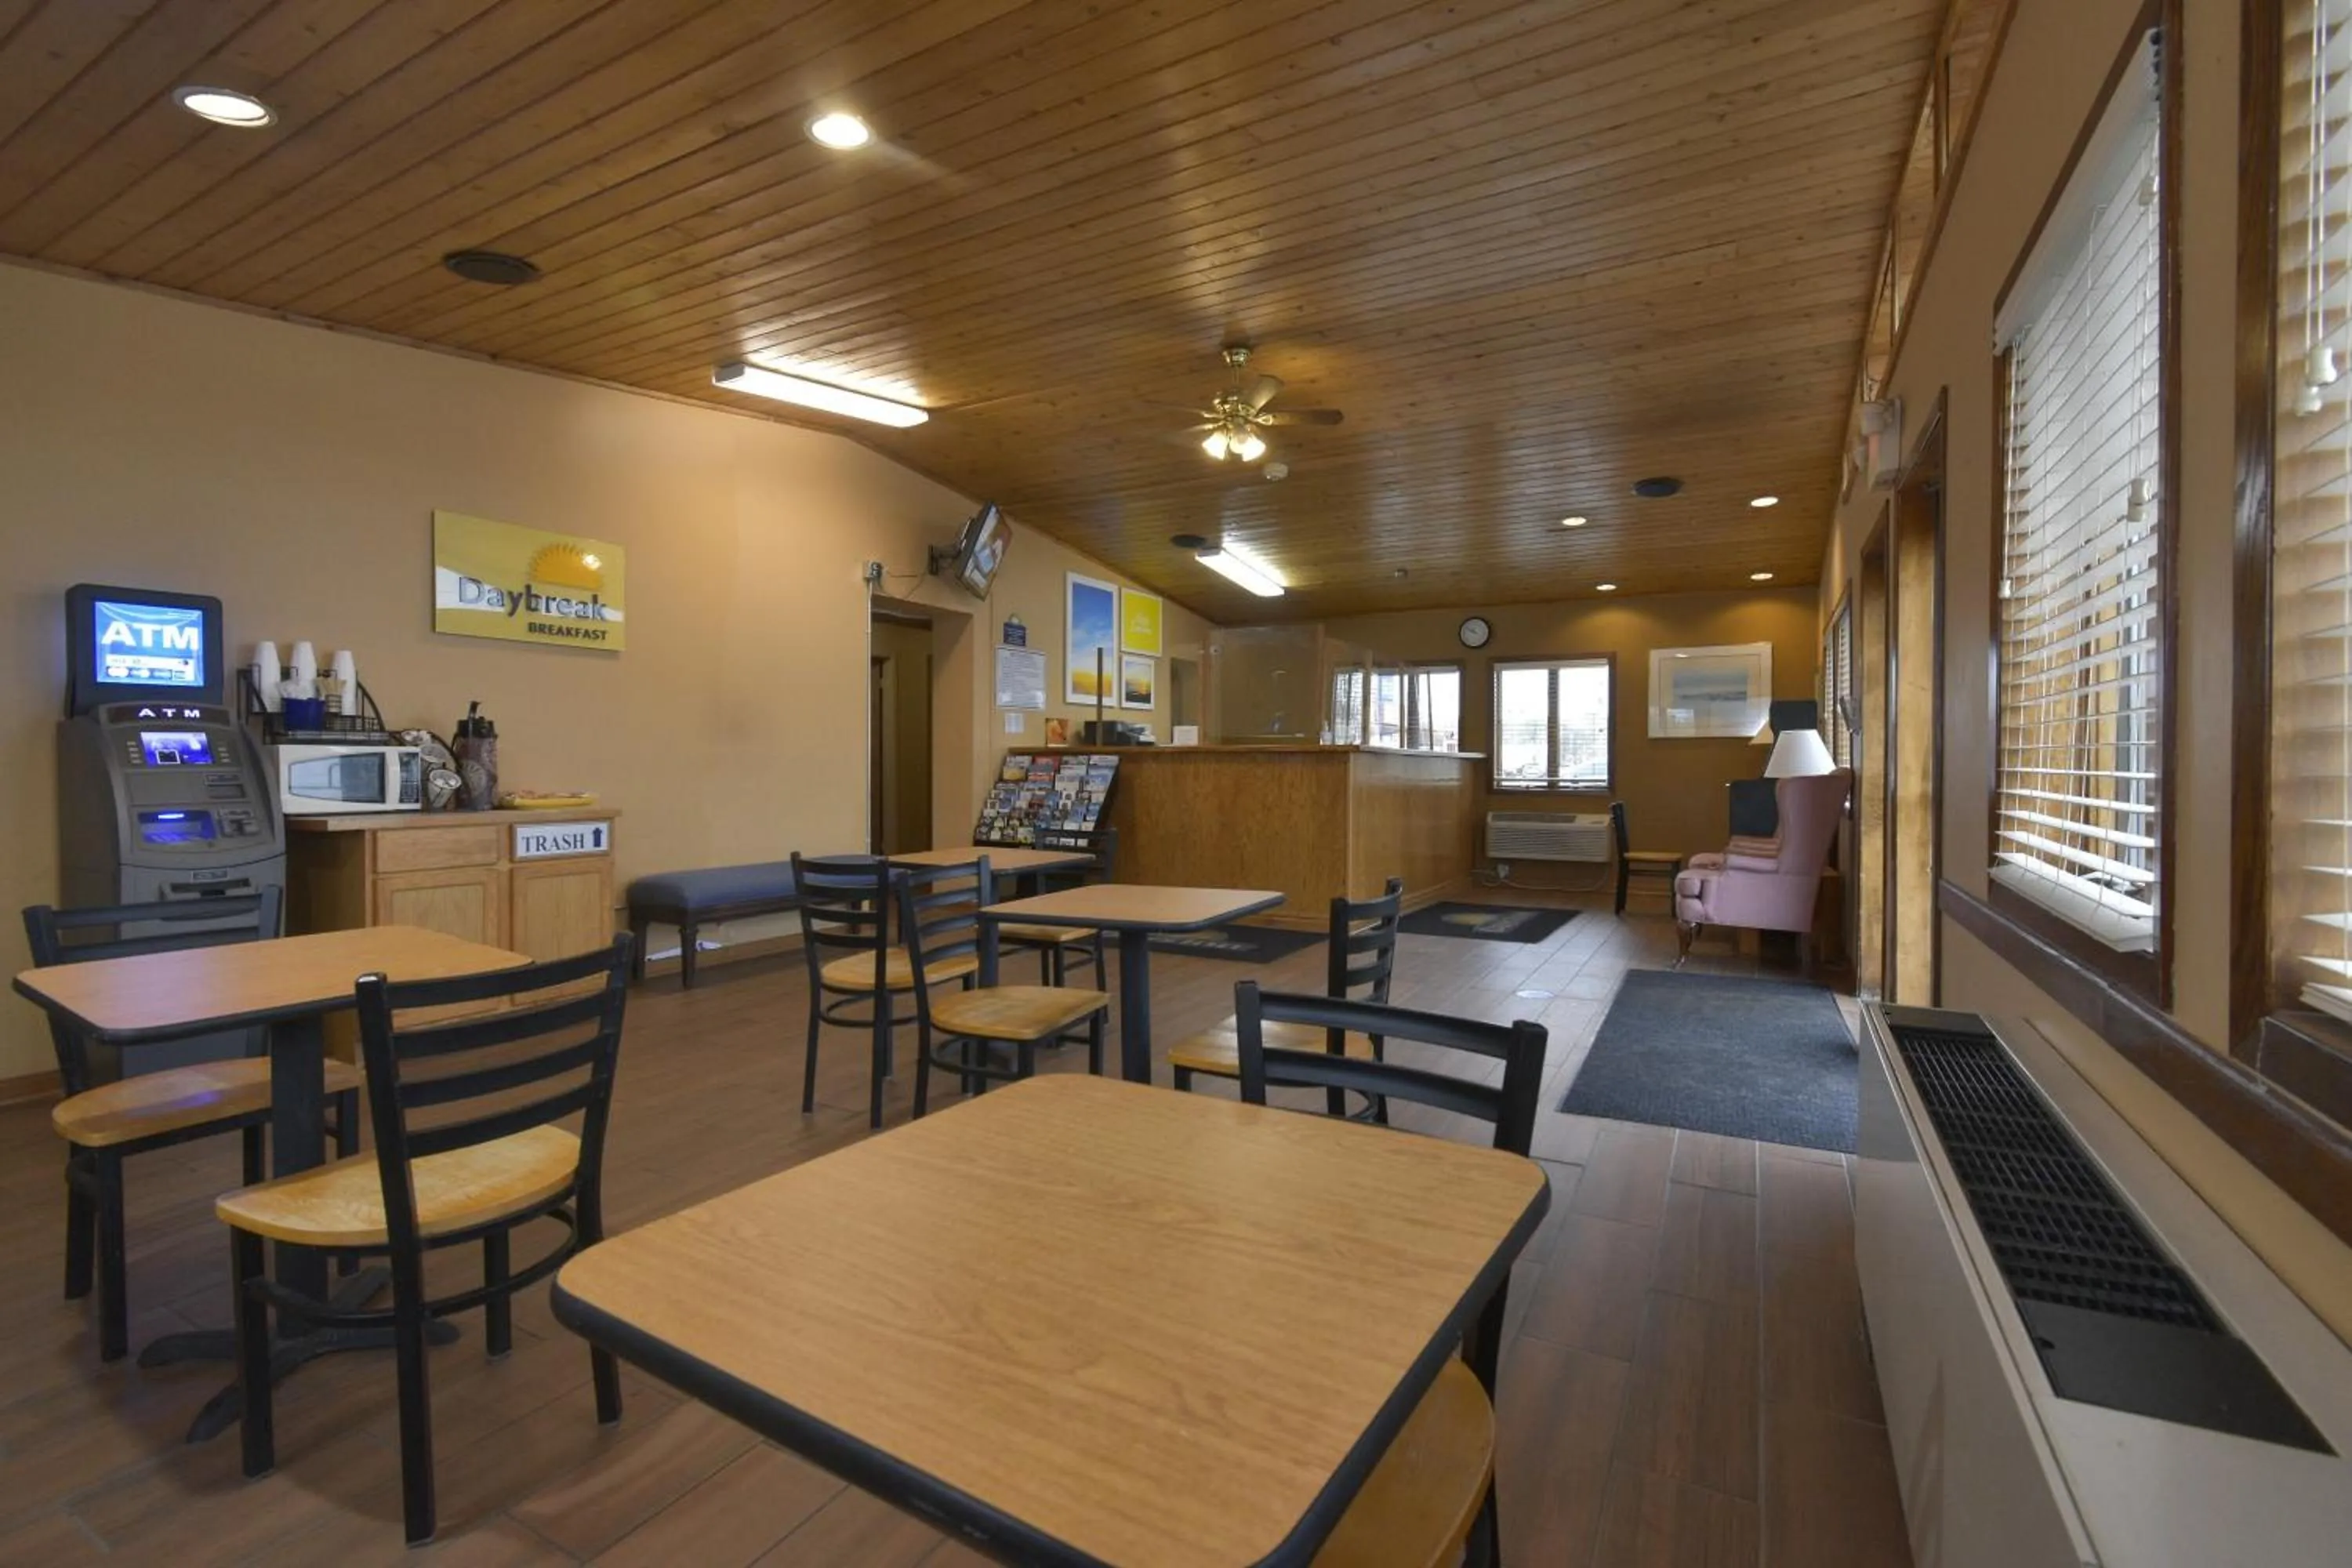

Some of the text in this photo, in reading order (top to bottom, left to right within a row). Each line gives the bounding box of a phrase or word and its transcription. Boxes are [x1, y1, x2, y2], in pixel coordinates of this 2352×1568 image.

[459, 577, 608, 621] Daybreak
[101, 621, 199, 650] ATM
[528, 621, 608, 641] BREAKFAST
[138, 708, 200, 718] ATM
[521, 833, 584, 853] TRASH
